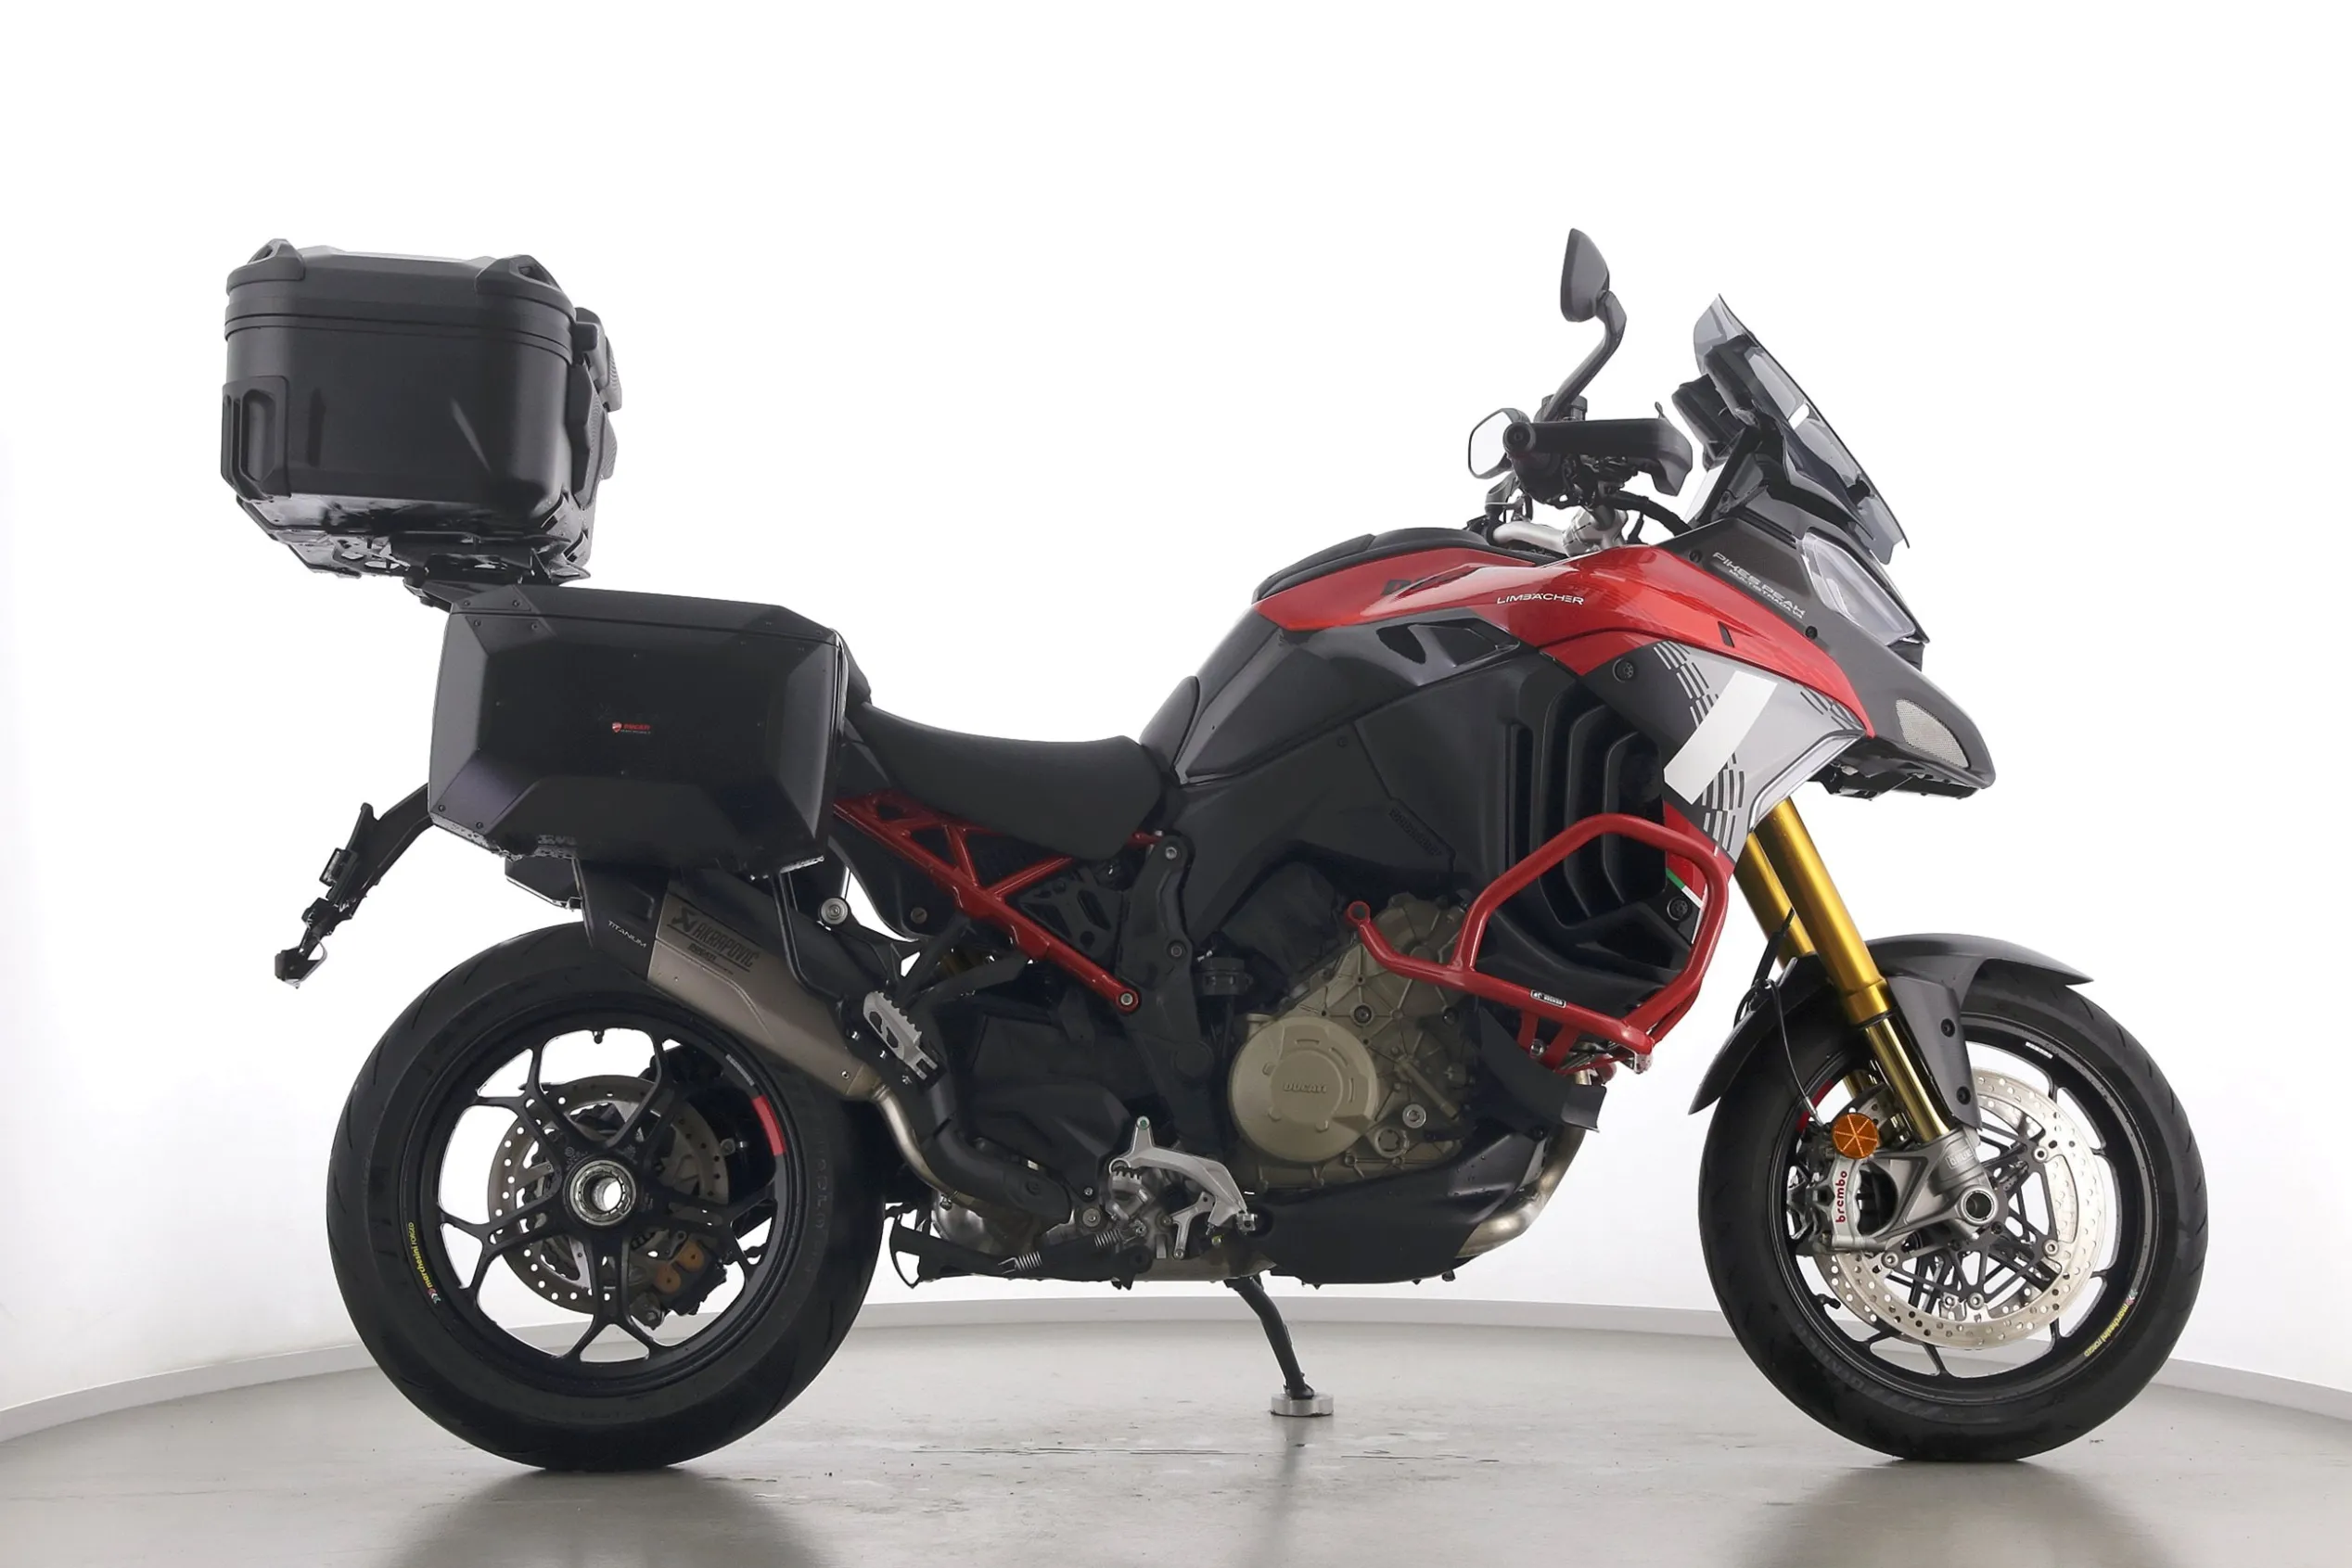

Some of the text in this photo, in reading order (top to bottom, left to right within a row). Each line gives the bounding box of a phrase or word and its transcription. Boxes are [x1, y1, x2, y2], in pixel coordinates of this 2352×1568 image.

[1712, 552, 1807, 616] PIKES PEAK
[608, 920, 647, 948] TITANIUM
[1284, 1082, 1328, 1094] DUCATI
[1834, 1170, 1848, 1223] brembo
